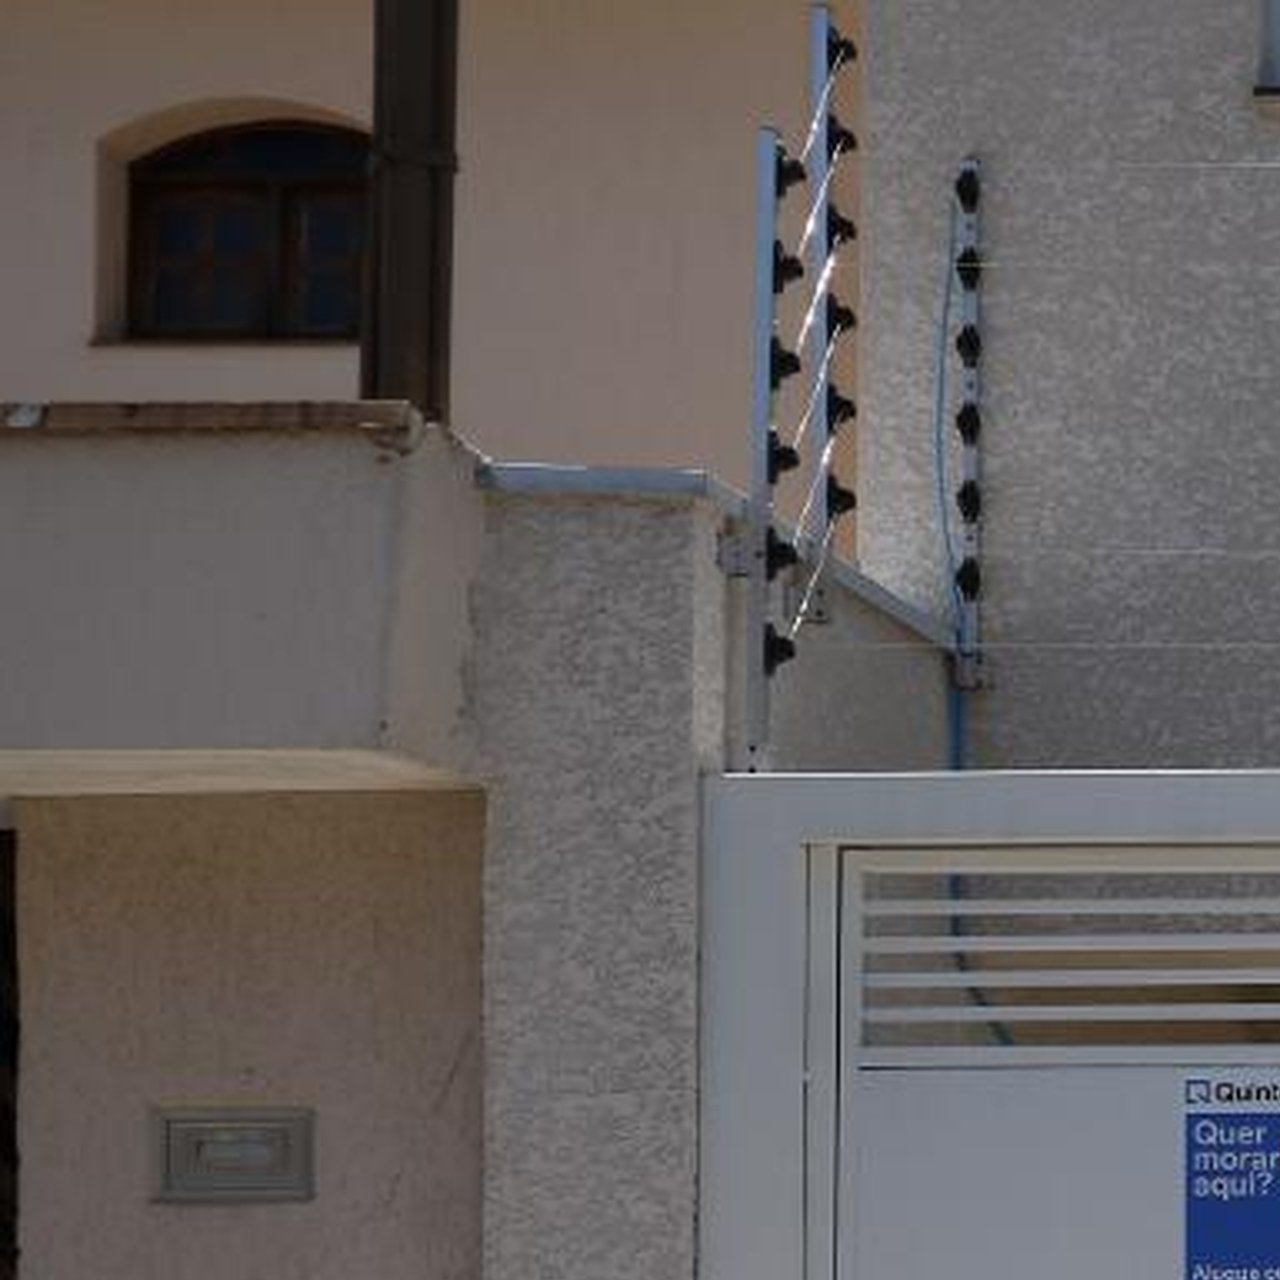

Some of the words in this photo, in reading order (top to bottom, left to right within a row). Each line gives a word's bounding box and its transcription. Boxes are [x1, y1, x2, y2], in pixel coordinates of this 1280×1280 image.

[1194, 1121, 1267, 1145] Quer
[1193, 1151, 1280, 1171] morar
[1194, 1172, 1273, 1200] aqui?
